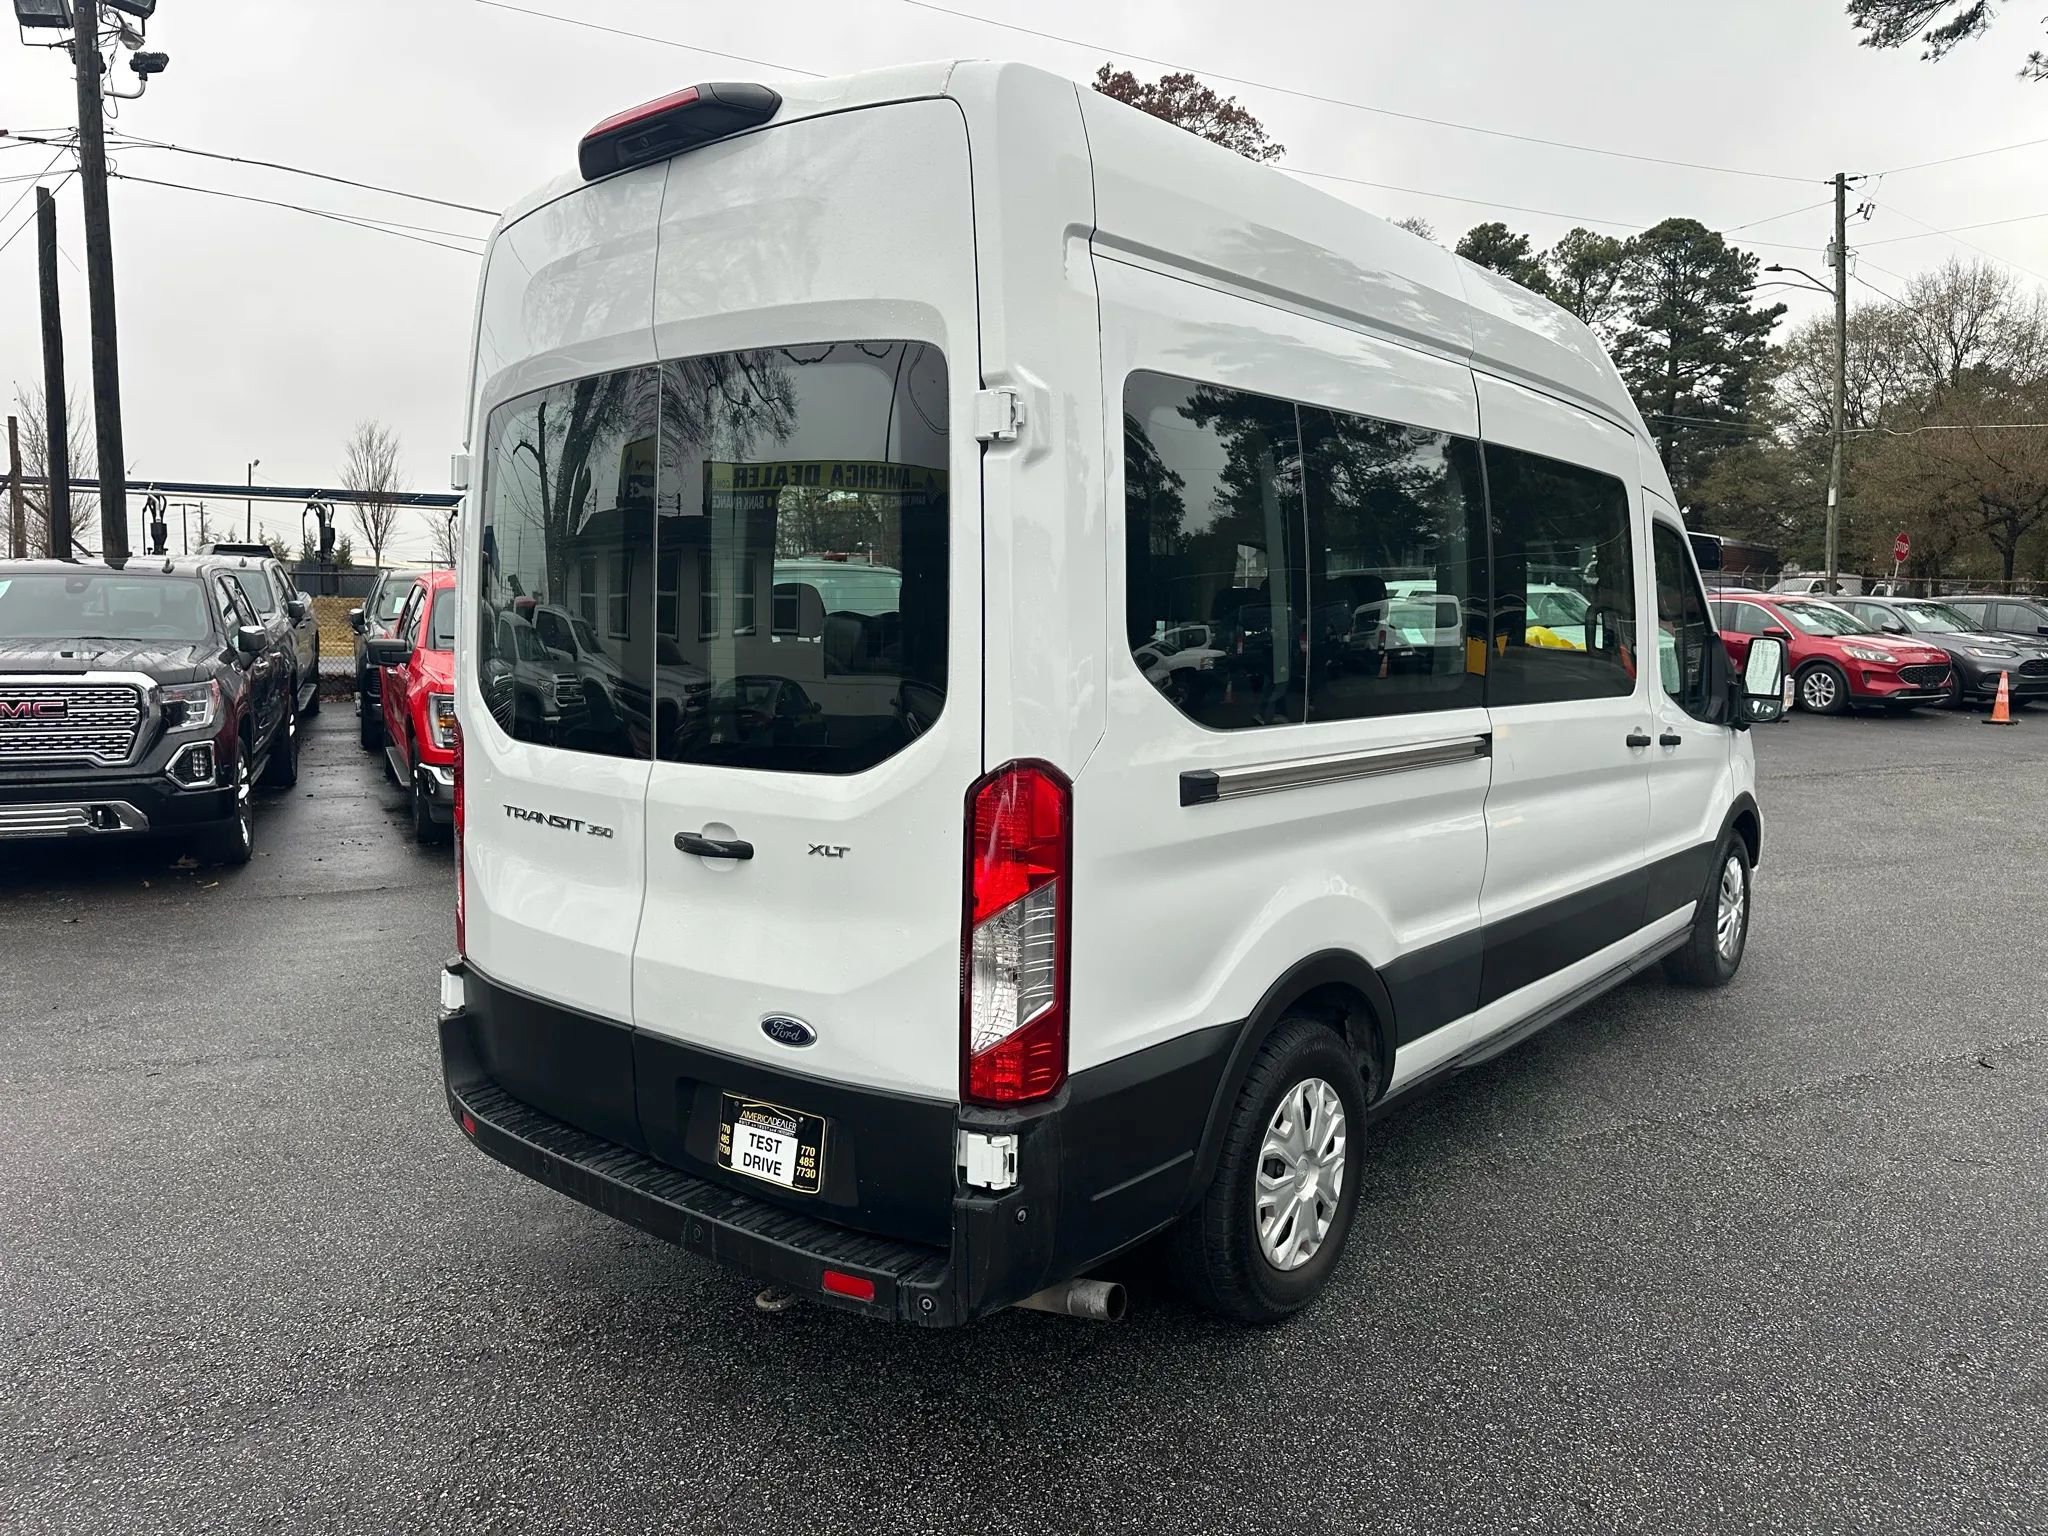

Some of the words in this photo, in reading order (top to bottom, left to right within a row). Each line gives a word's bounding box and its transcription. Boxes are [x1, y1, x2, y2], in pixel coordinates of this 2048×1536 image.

[1895, 540, 1909, 554] STOP
[0, 701, 65, 718] MC
[503, 804, 586, 832] TRANSIT
[586, 824, 614, 839] 350
[808, 843, 851, 859] XLT
[770, 1020, 801, 1041] Ford
[721, 1123, 731, 1134] 770
[740, 1110, 797, 1131] AMERICADEALER
[720, 1134, 730, 1144] 485
[749, 1133, 782, 1154] TEST
[801, 1145, 815, 1156] 770
[743, 1152, 782, 1176] DRIVE
[799, 1156, 815, 1167] 485
[796, 1166, 816, 1179] 7730
